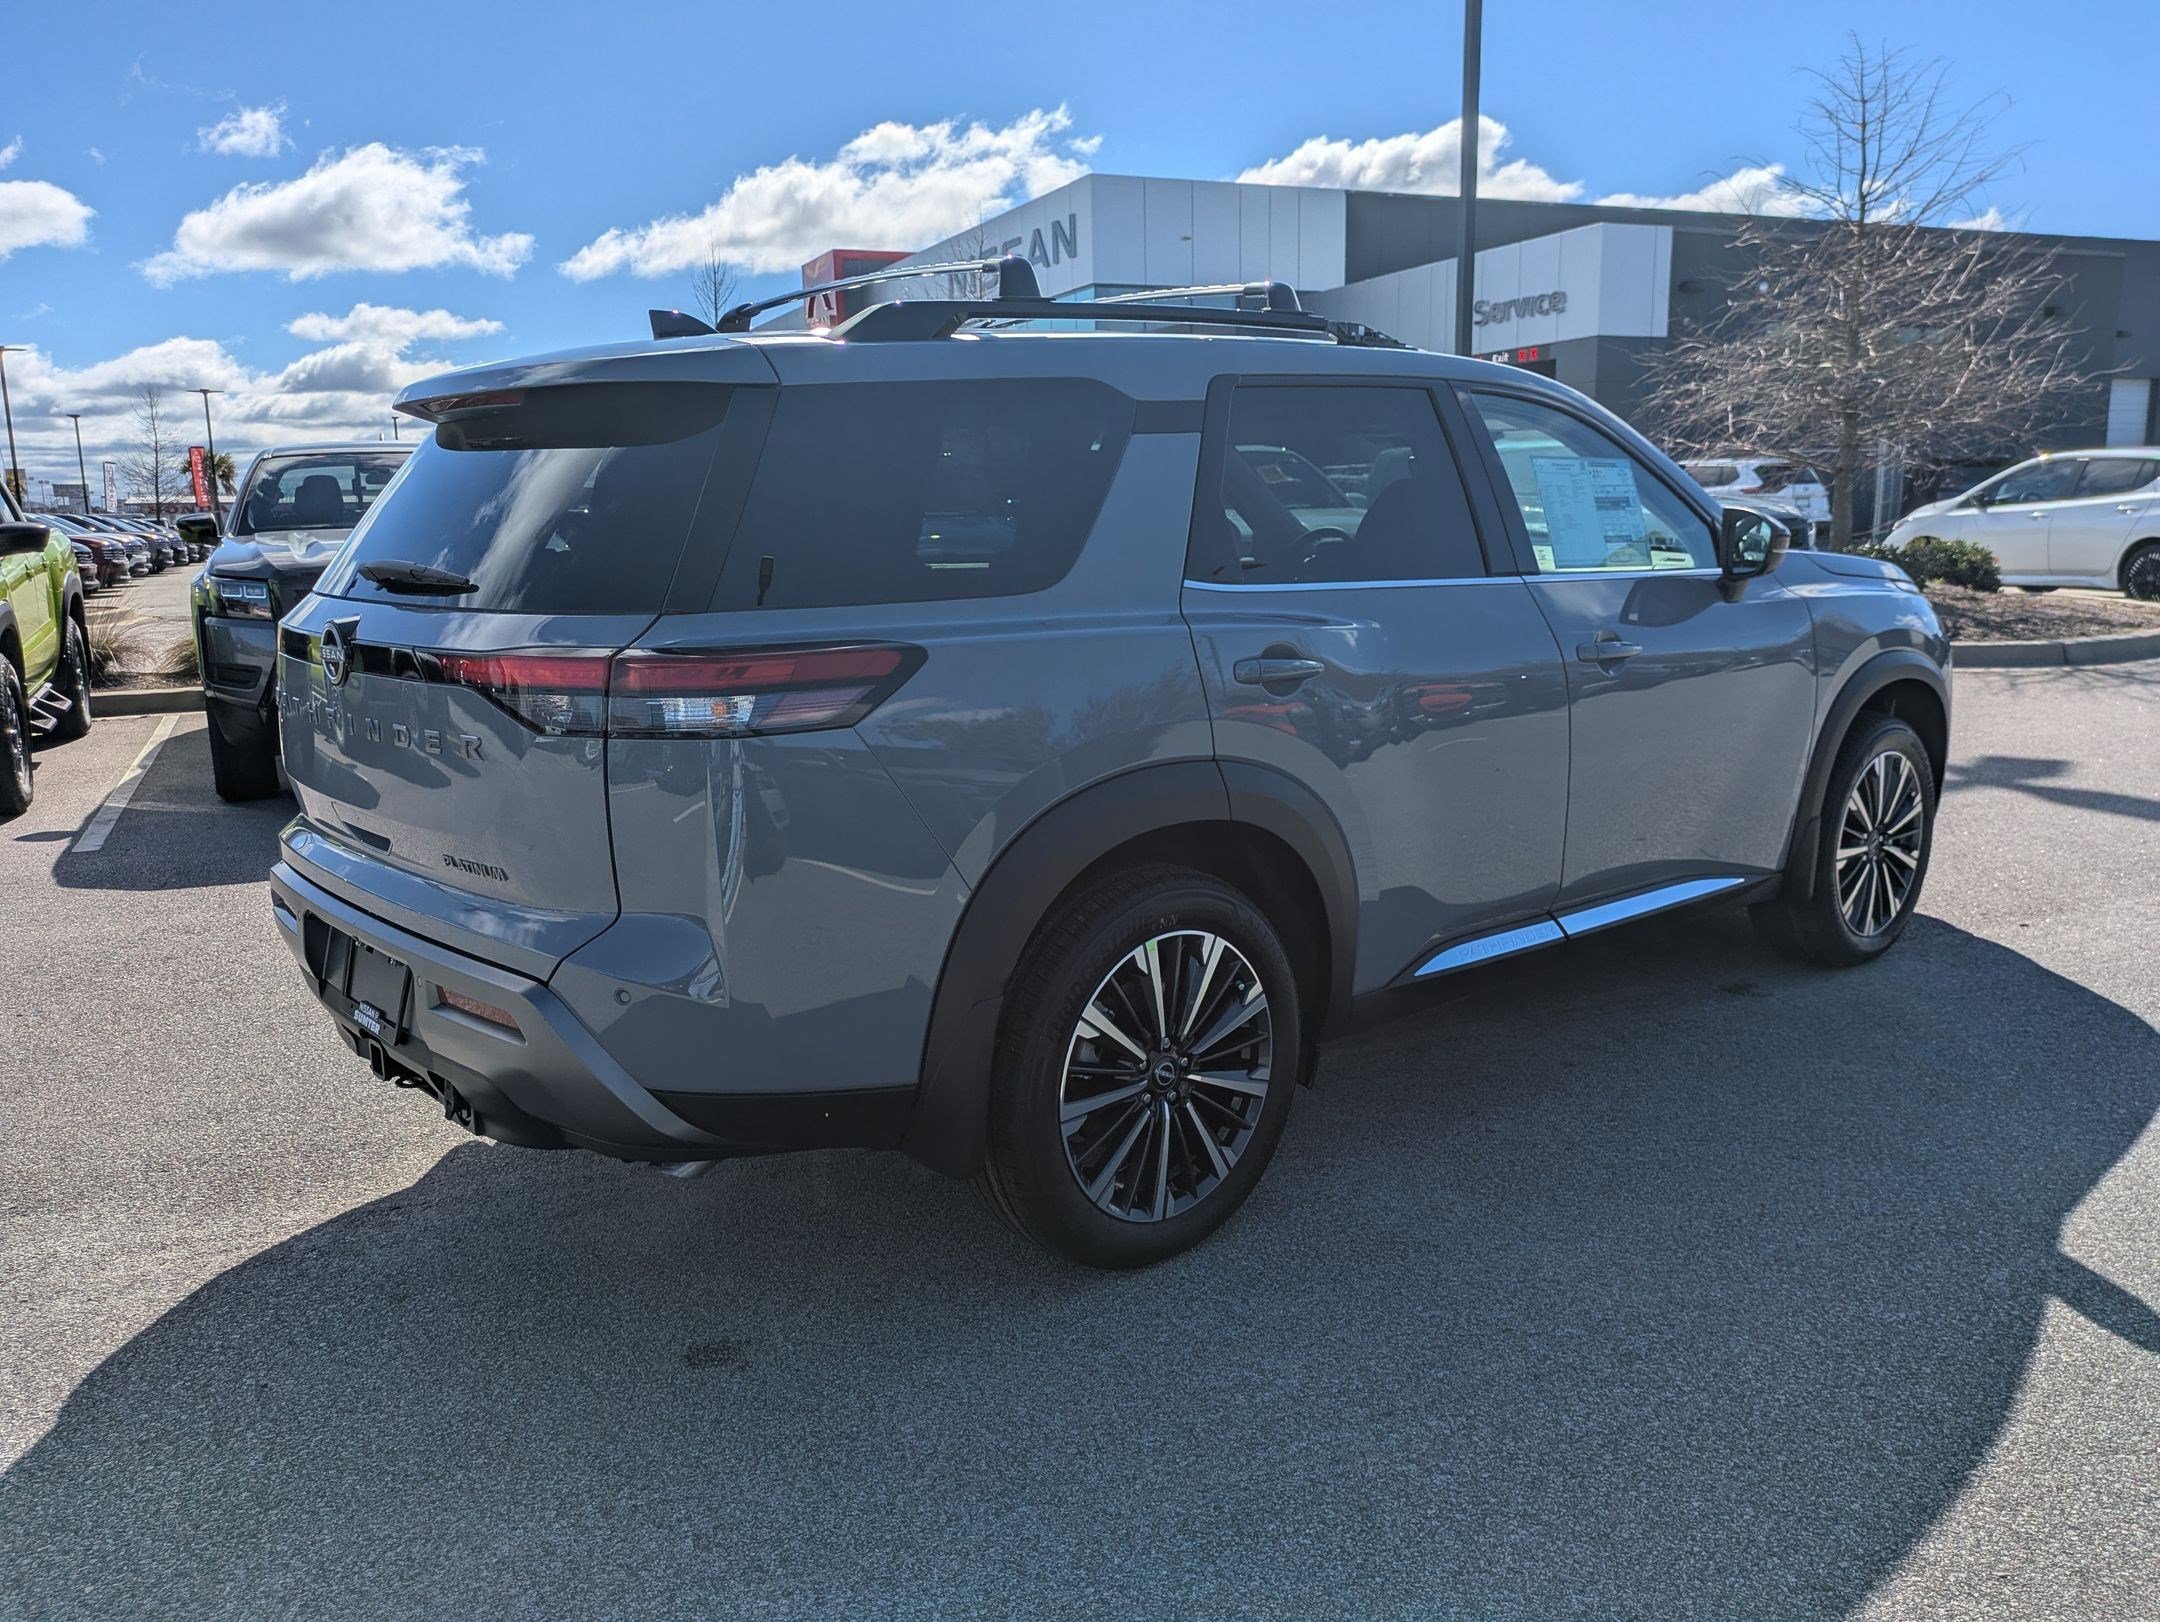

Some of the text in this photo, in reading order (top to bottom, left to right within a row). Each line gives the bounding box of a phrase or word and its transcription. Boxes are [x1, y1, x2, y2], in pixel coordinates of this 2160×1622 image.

[1473, 291, 1567, 326] Service
[279, 688, 484, 760] ATHFINDER
[442, 853, 509, 881] PLATINUM
[353, 1009, 380, 1035] SUMTER
